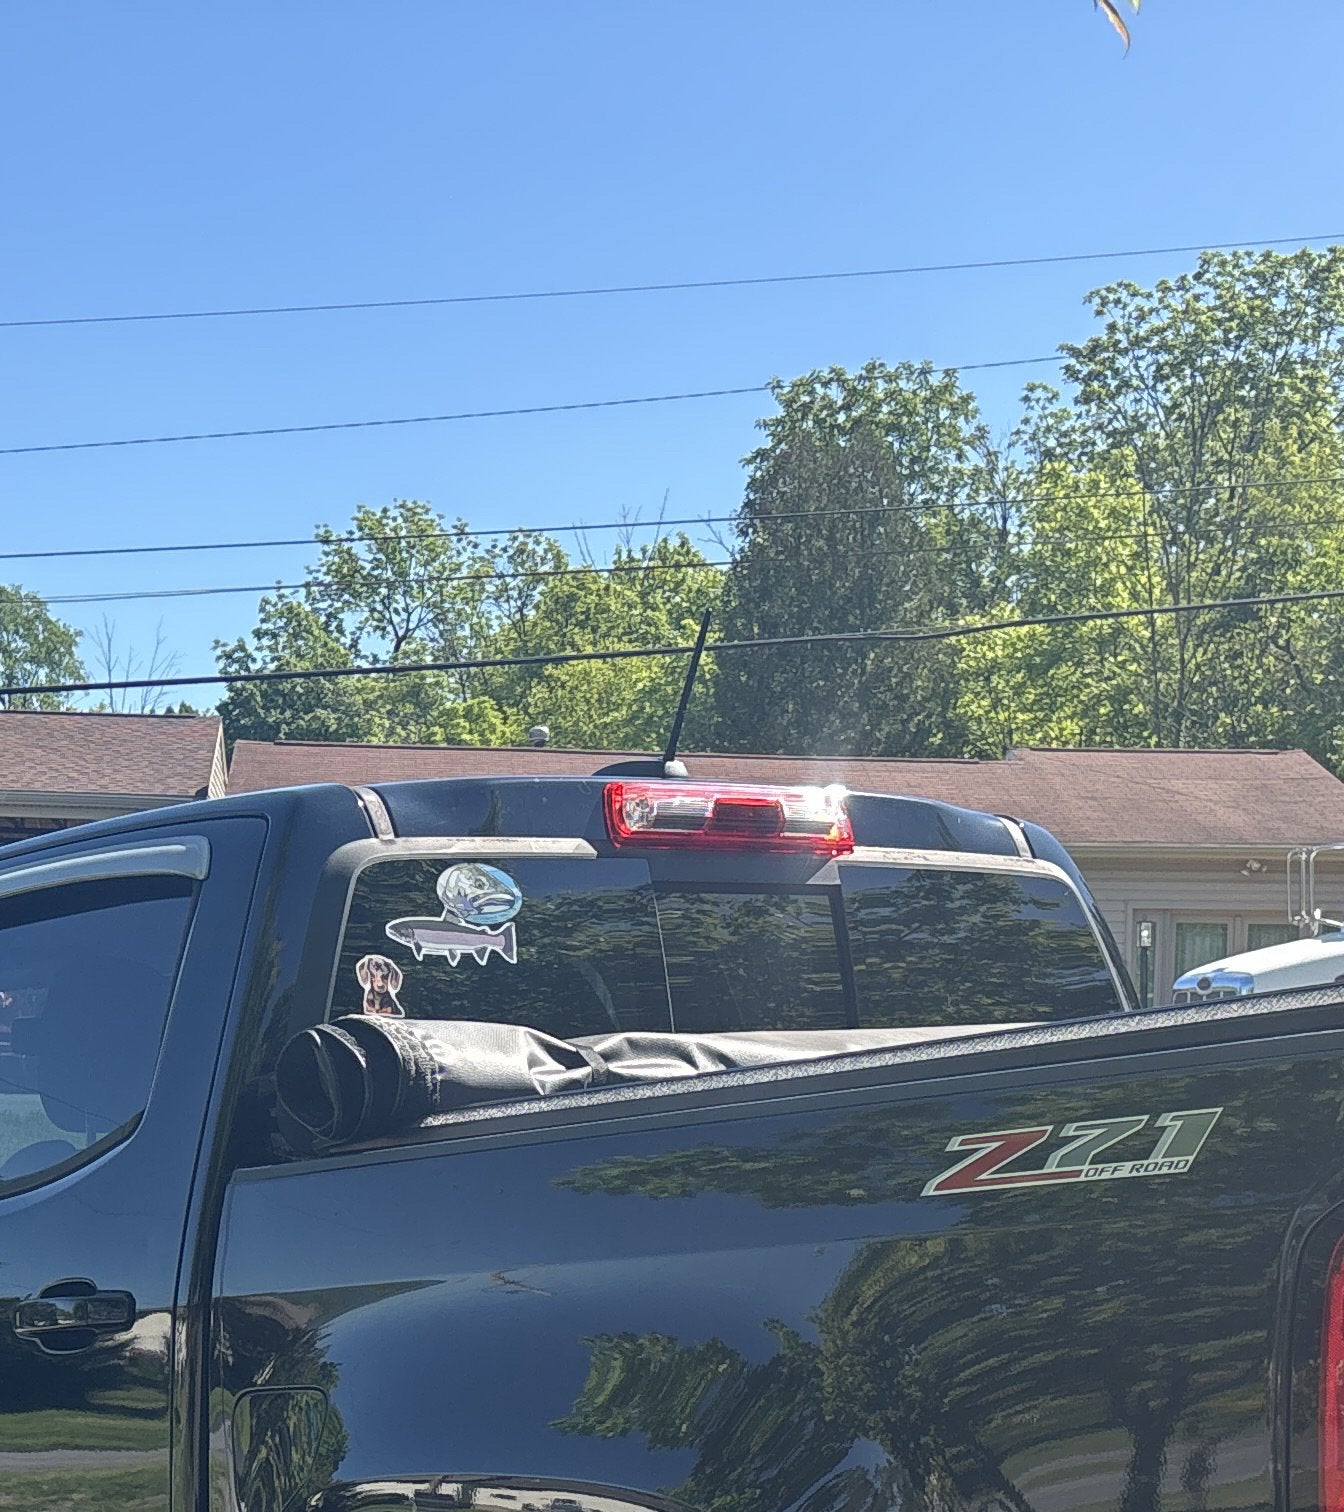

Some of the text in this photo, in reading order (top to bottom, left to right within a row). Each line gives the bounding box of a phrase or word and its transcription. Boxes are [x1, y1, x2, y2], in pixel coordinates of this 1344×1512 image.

[921, 1106, 1224, 1197] Z71
[1084, 1159, 1190, 1178] OFF ROAD
